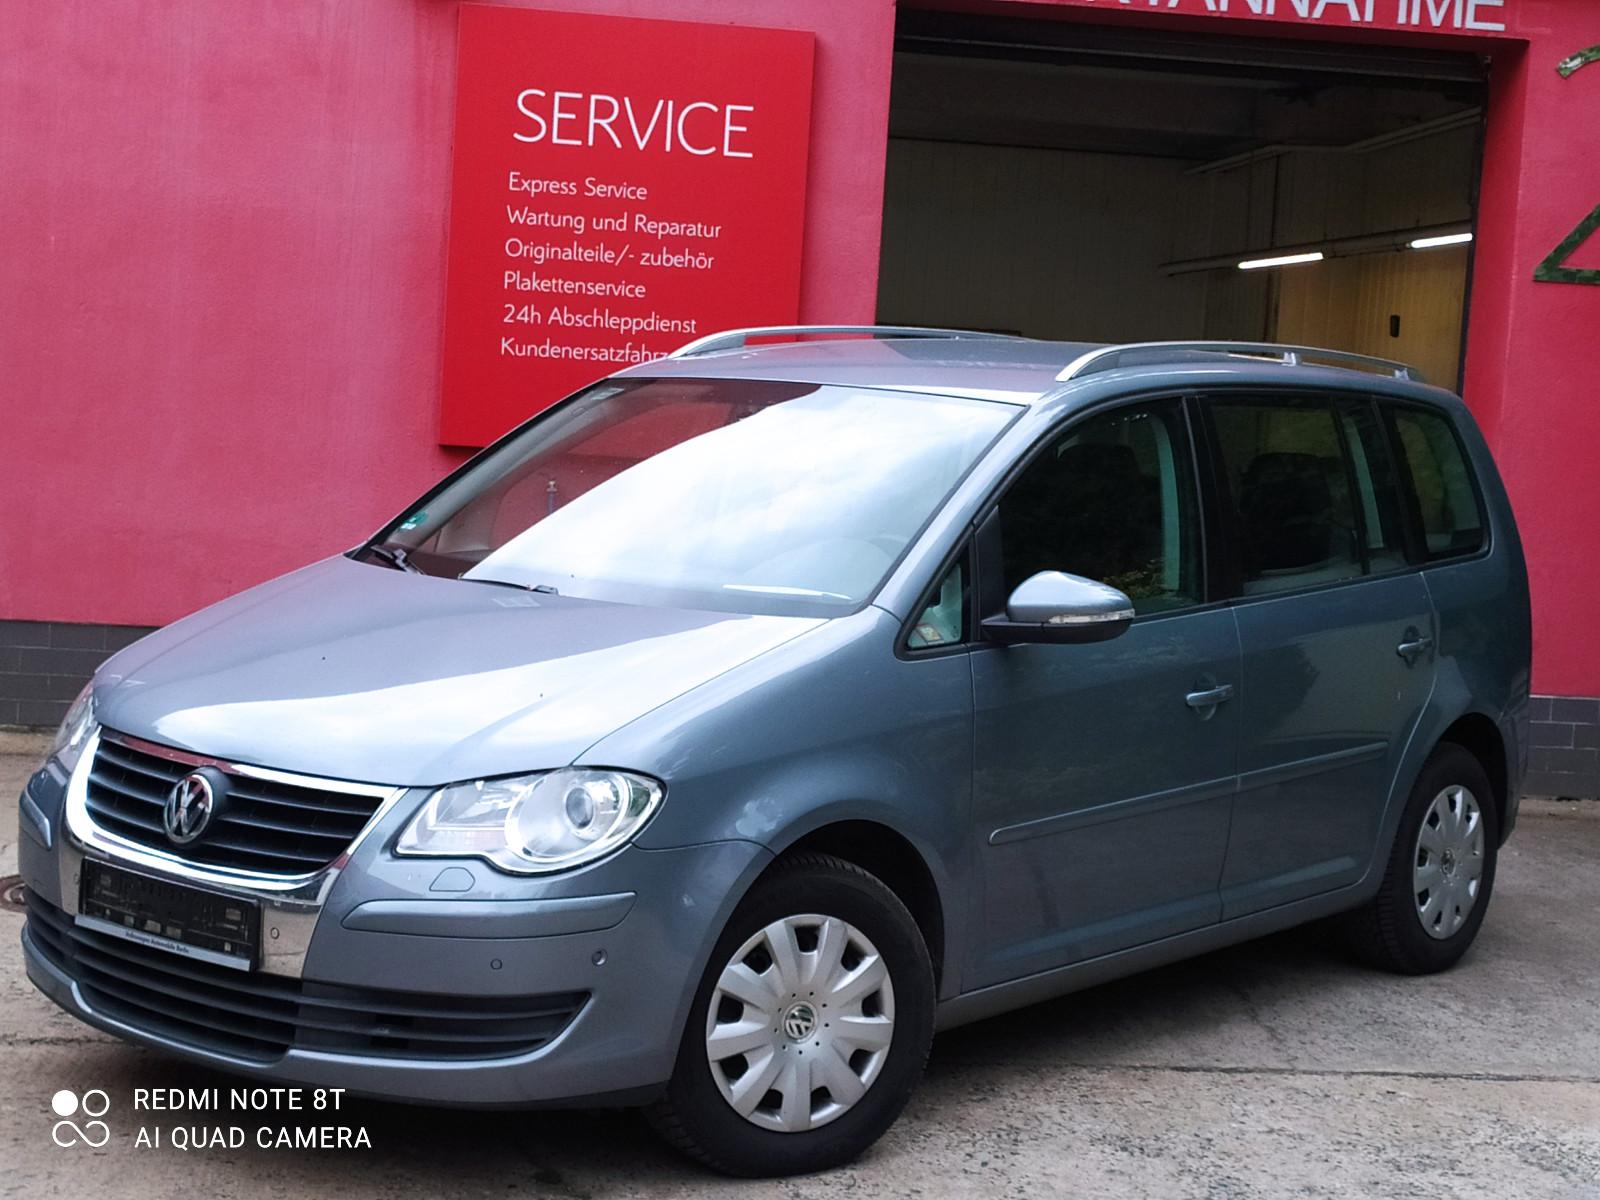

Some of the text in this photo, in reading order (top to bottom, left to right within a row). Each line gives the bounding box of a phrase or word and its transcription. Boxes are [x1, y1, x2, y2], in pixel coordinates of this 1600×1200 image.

[513, 88, 754, 158] SERVICE
[509, 171, 648, 200] Express Service
[506, 205, 722, 240] Wartung und Reparatur
[505, 238, 714, 269] Originalteile/- zubehör
[504, 270, 646, 298] Plakettenservice
[503, 303, 697, 335] 24h Abschleppdienst
